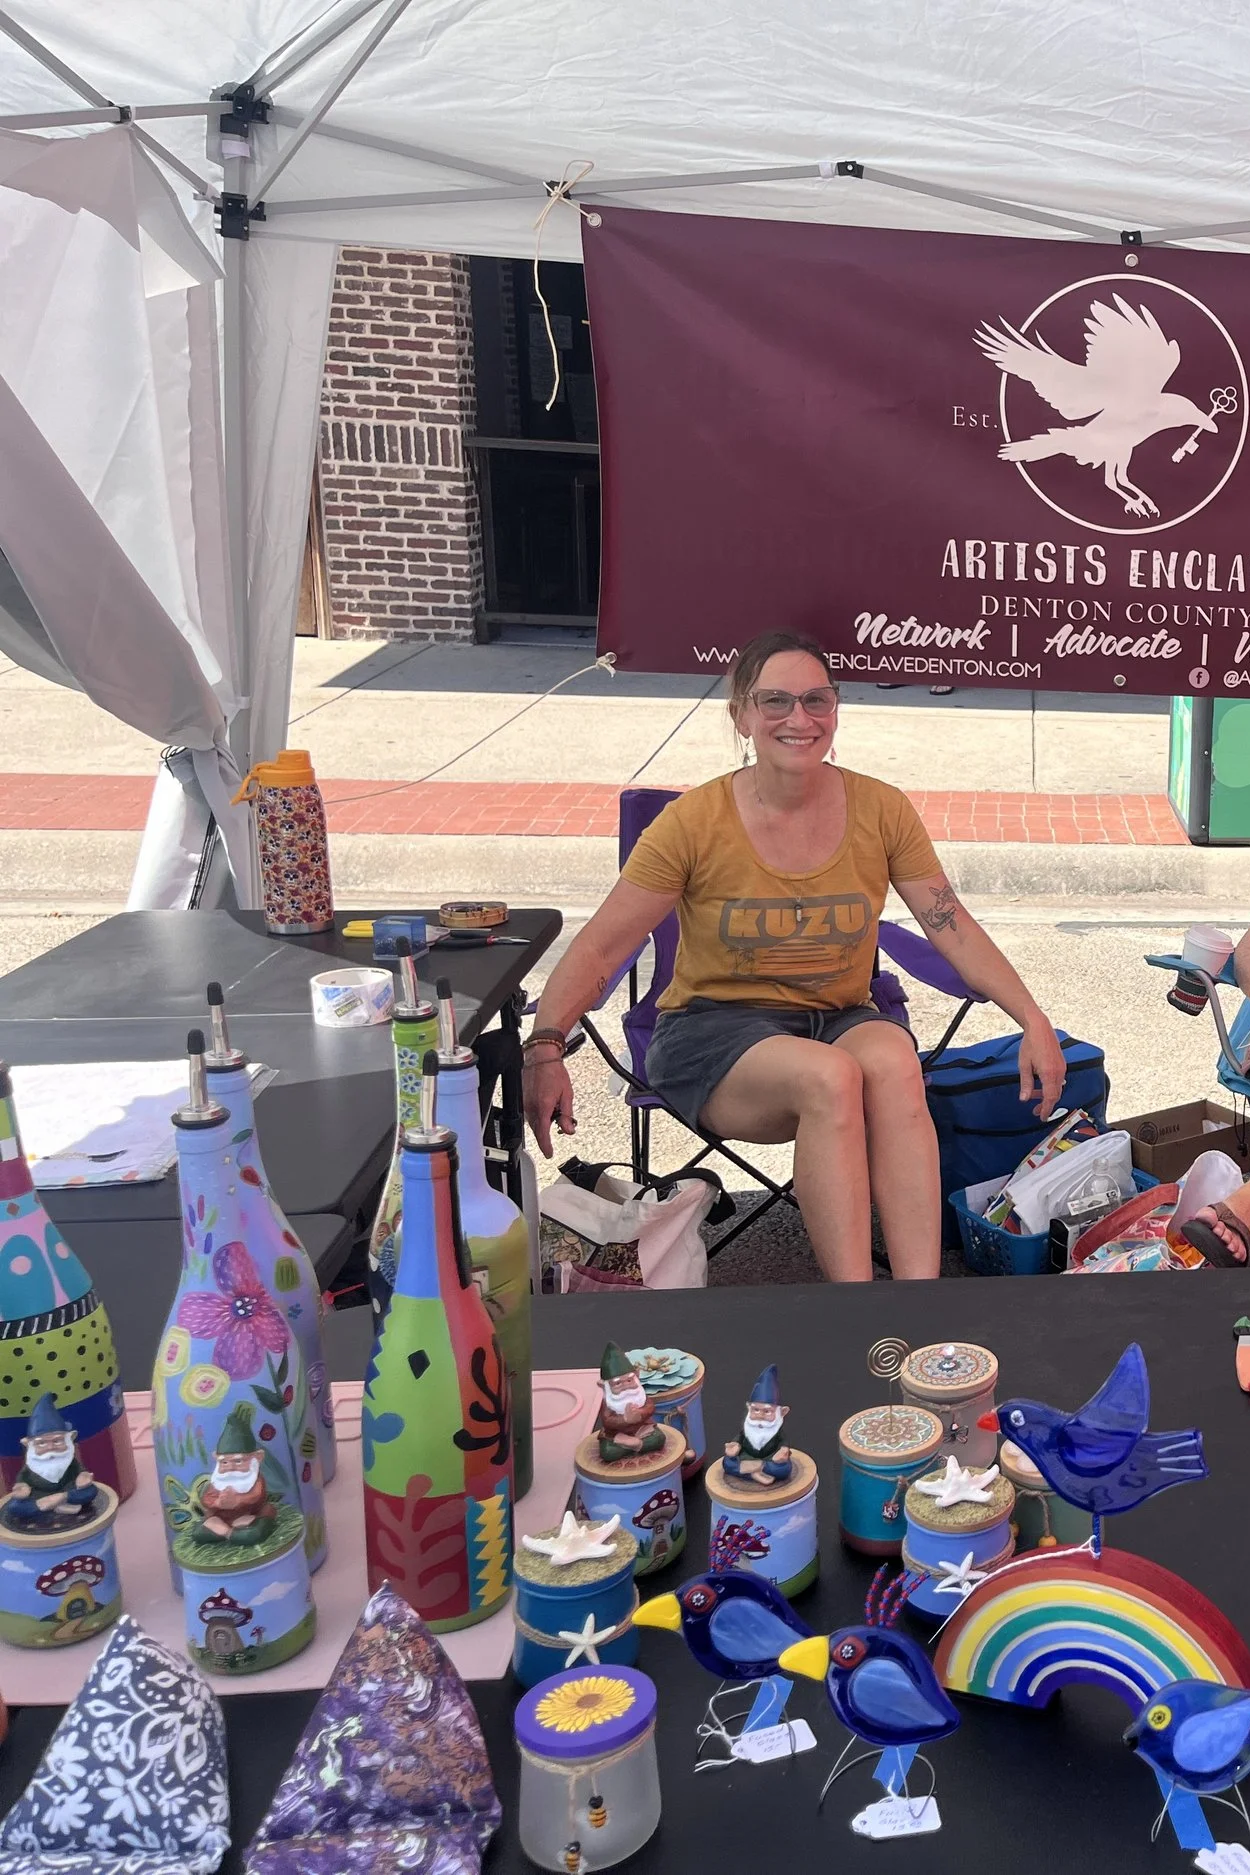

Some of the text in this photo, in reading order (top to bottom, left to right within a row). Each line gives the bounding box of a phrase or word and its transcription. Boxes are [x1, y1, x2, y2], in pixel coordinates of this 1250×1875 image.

[952, 405, 998, 428] Est.
[941, 538, 1107, 586] ARTISTS
[980, 595, 1112, 622] DENTON
[854, 611, 992, 650] Network
[1044, 623, 1183, 659] Advocate
[726, 902, 867, 939] KUZU
